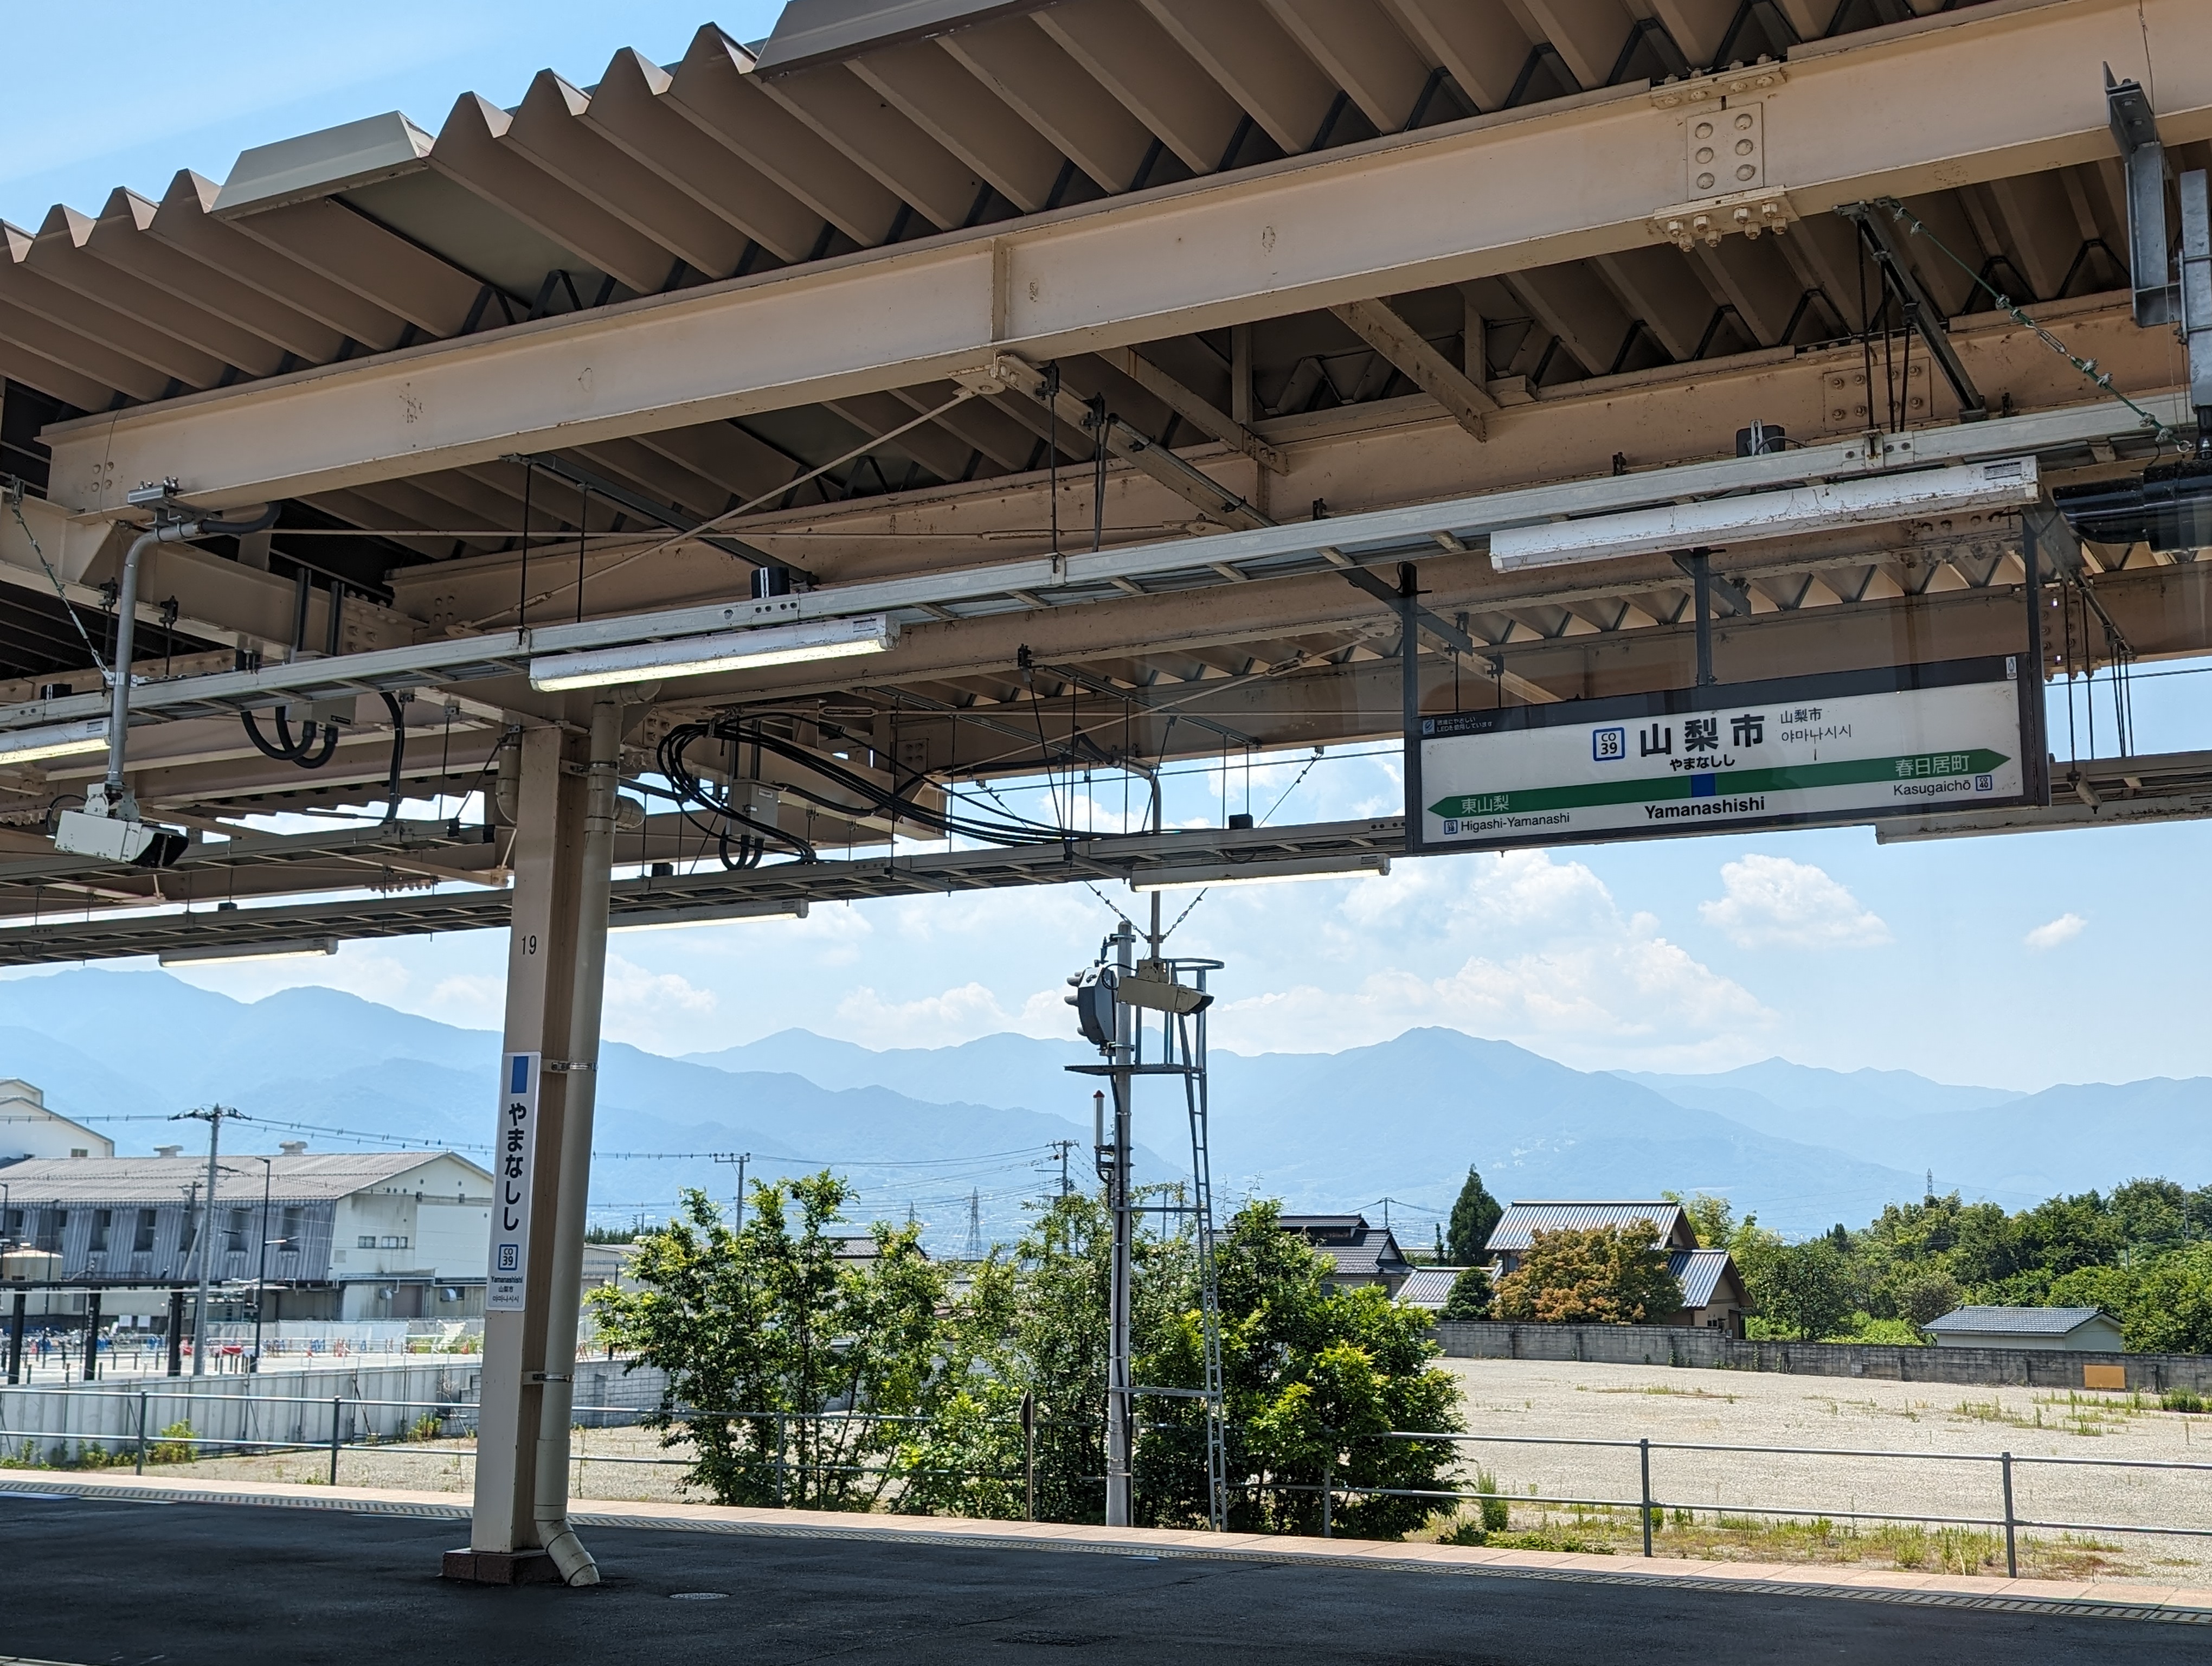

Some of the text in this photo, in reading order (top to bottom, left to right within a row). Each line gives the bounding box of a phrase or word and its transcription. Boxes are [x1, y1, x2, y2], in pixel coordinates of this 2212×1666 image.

[1780, 707, 1822, 724] 山梨市
[1601, 733, 1616, 742] CO
[1640, 714, 1765, 757] 山梨市
[1782, 724, 1851, 744] 야마나시시
[1600, 742, 1618, 755] 39
[1670, 754, 1735, 771] やまなしし
[1895, 754, 1970, 777] 春日居町
[1893, 779, 1971, 796] Kasugaichō
[1461, 794, 1509, 814] 東山梨
[1644, 796, 1765, 819] Yamanashishi
[1461, 812, 1570, 834] Higashi-Yamanashi
[521, 935, 537, 955] 19
[504, 1102, 527, 1231] やまなしし
[502, 1255, 513, 1266] 39
